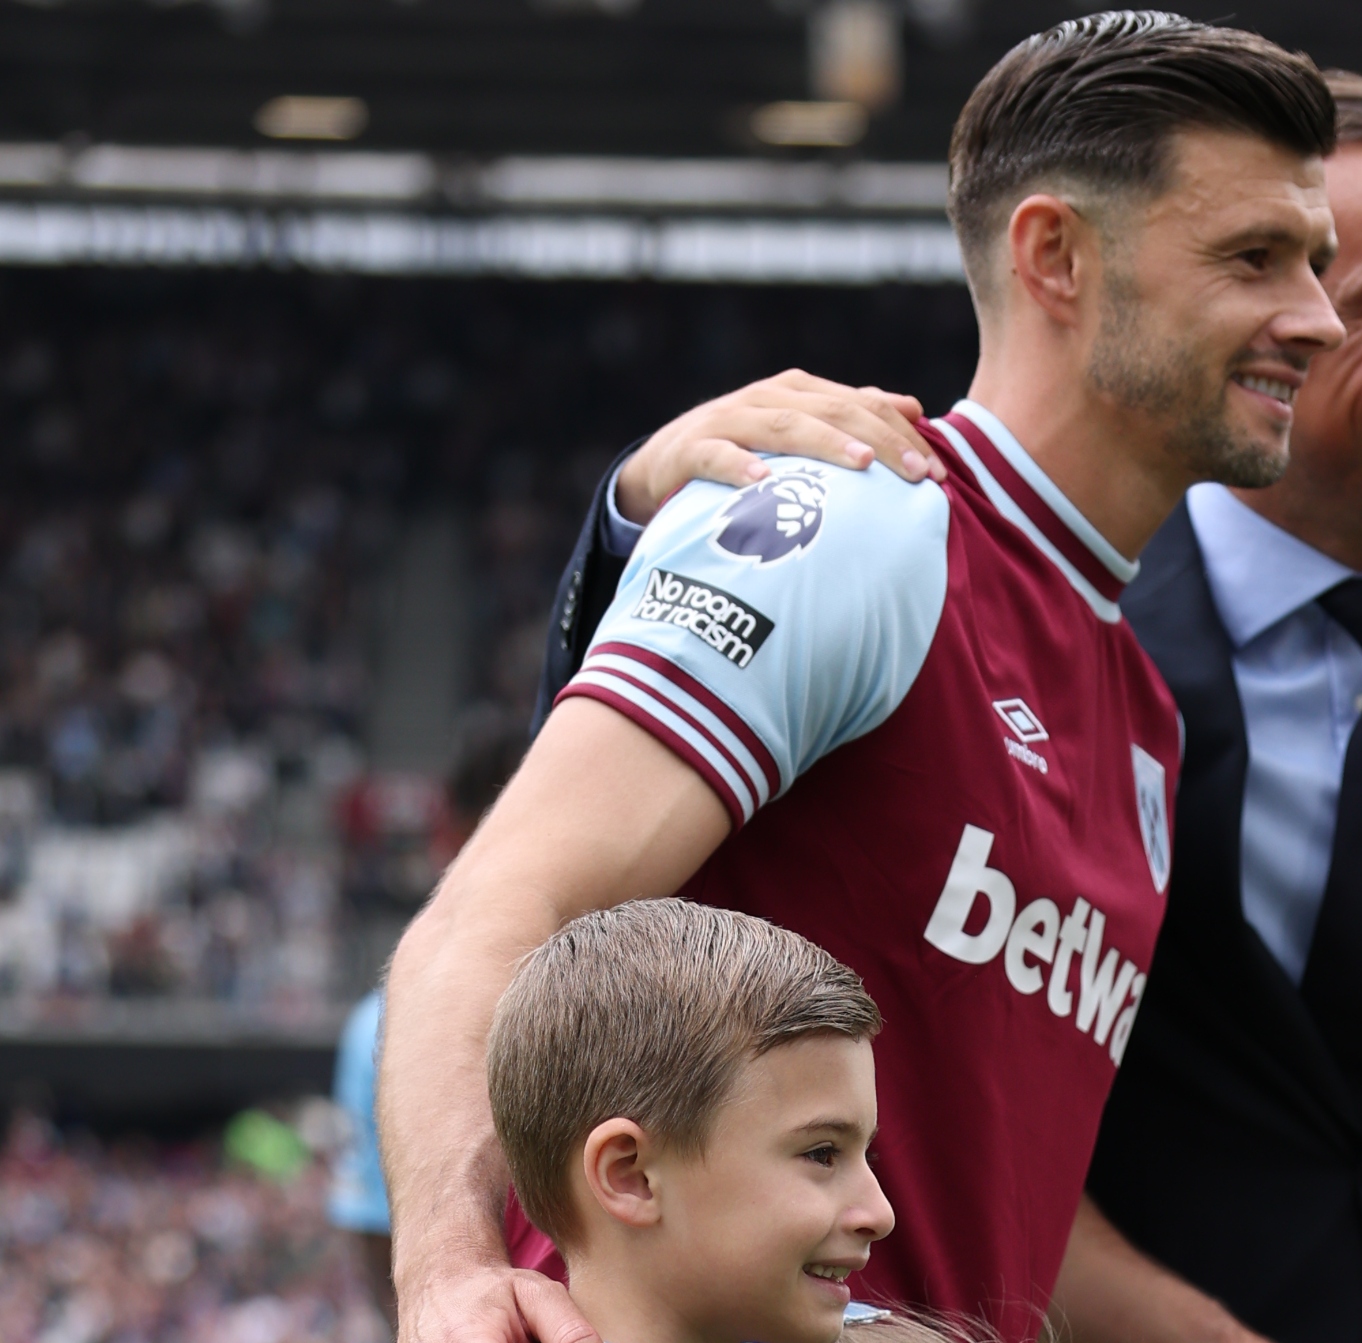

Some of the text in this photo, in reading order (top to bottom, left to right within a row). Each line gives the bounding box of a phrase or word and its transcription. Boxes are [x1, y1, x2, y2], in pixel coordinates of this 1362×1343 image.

[632, 595, 754, 668] for racism
[644, 568, 757, 639] No room
[1003, 736, 1049, 775] umbro
